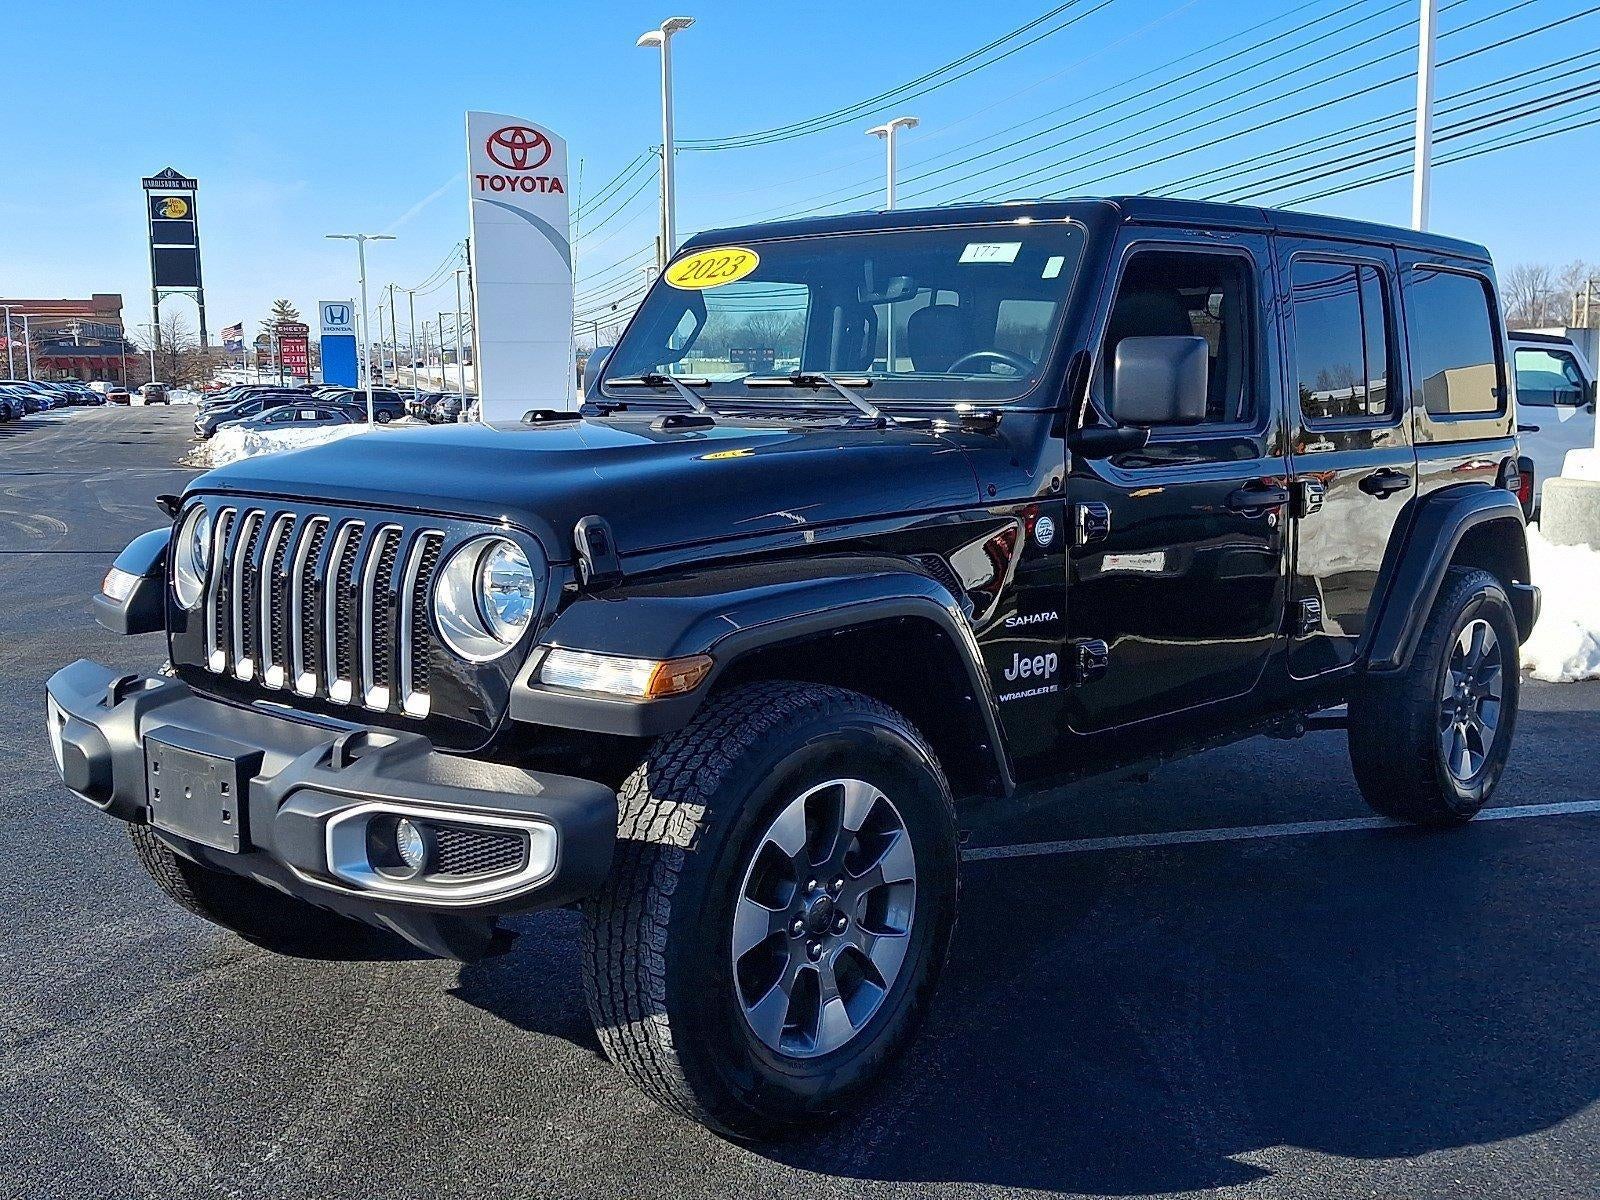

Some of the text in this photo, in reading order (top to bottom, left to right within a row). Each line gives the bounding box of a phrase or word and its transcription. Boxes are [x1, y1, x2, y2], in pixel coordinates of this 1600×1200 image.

[475, 174, 564, 194] TOYOTA
[677, 255, 747, 282] 2023
[1005, 611, 1059, 628] SAHARA
[1004, 652, 1058, 681] Jeep
[999, 686, 1049, 703] WRANGLER
